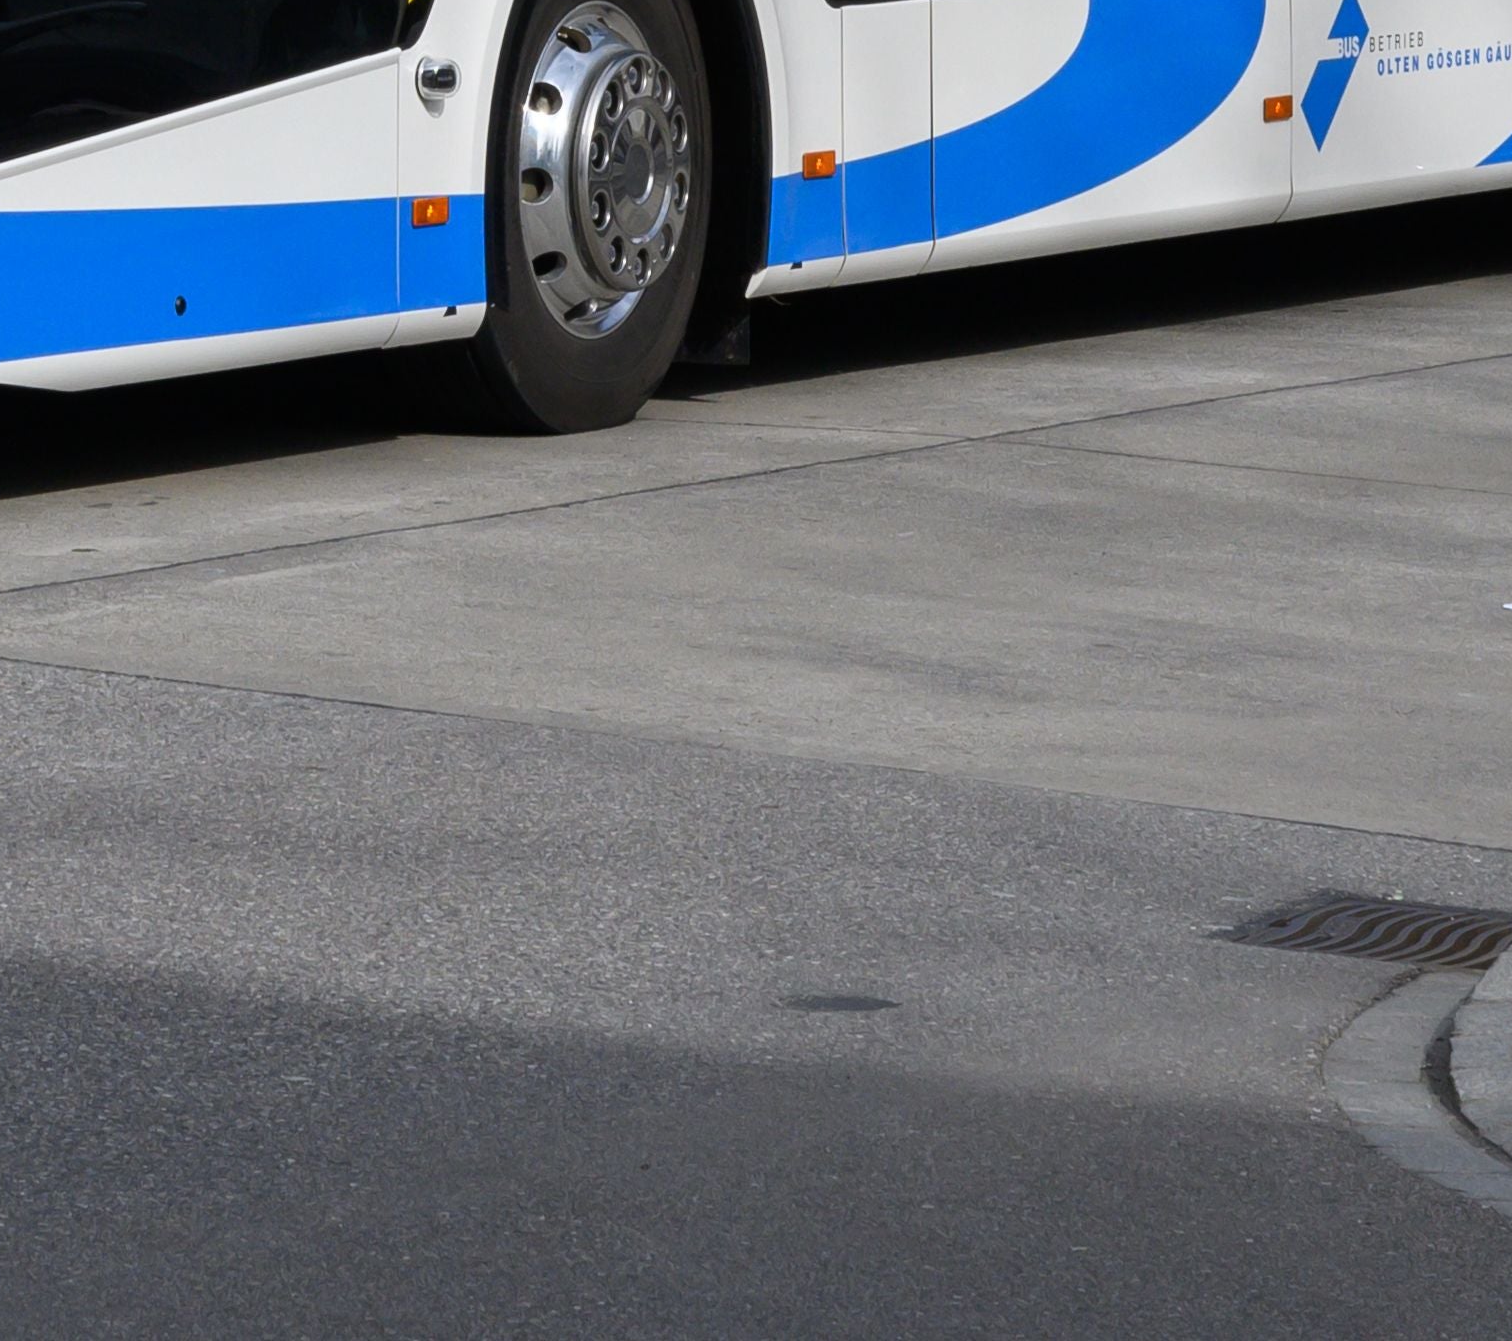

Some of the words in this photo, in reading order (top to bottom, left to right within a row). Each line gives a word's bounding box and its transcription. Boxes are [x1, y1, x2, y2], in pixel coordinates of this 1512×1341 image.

[1368, 31, 1425, 53] BETRIEB
[1377, 55, 1420, 76] OLTEN
[1427, 47, 1480, 70] GÖSGEN
[1486, 40, 1512, 63] GÄU
